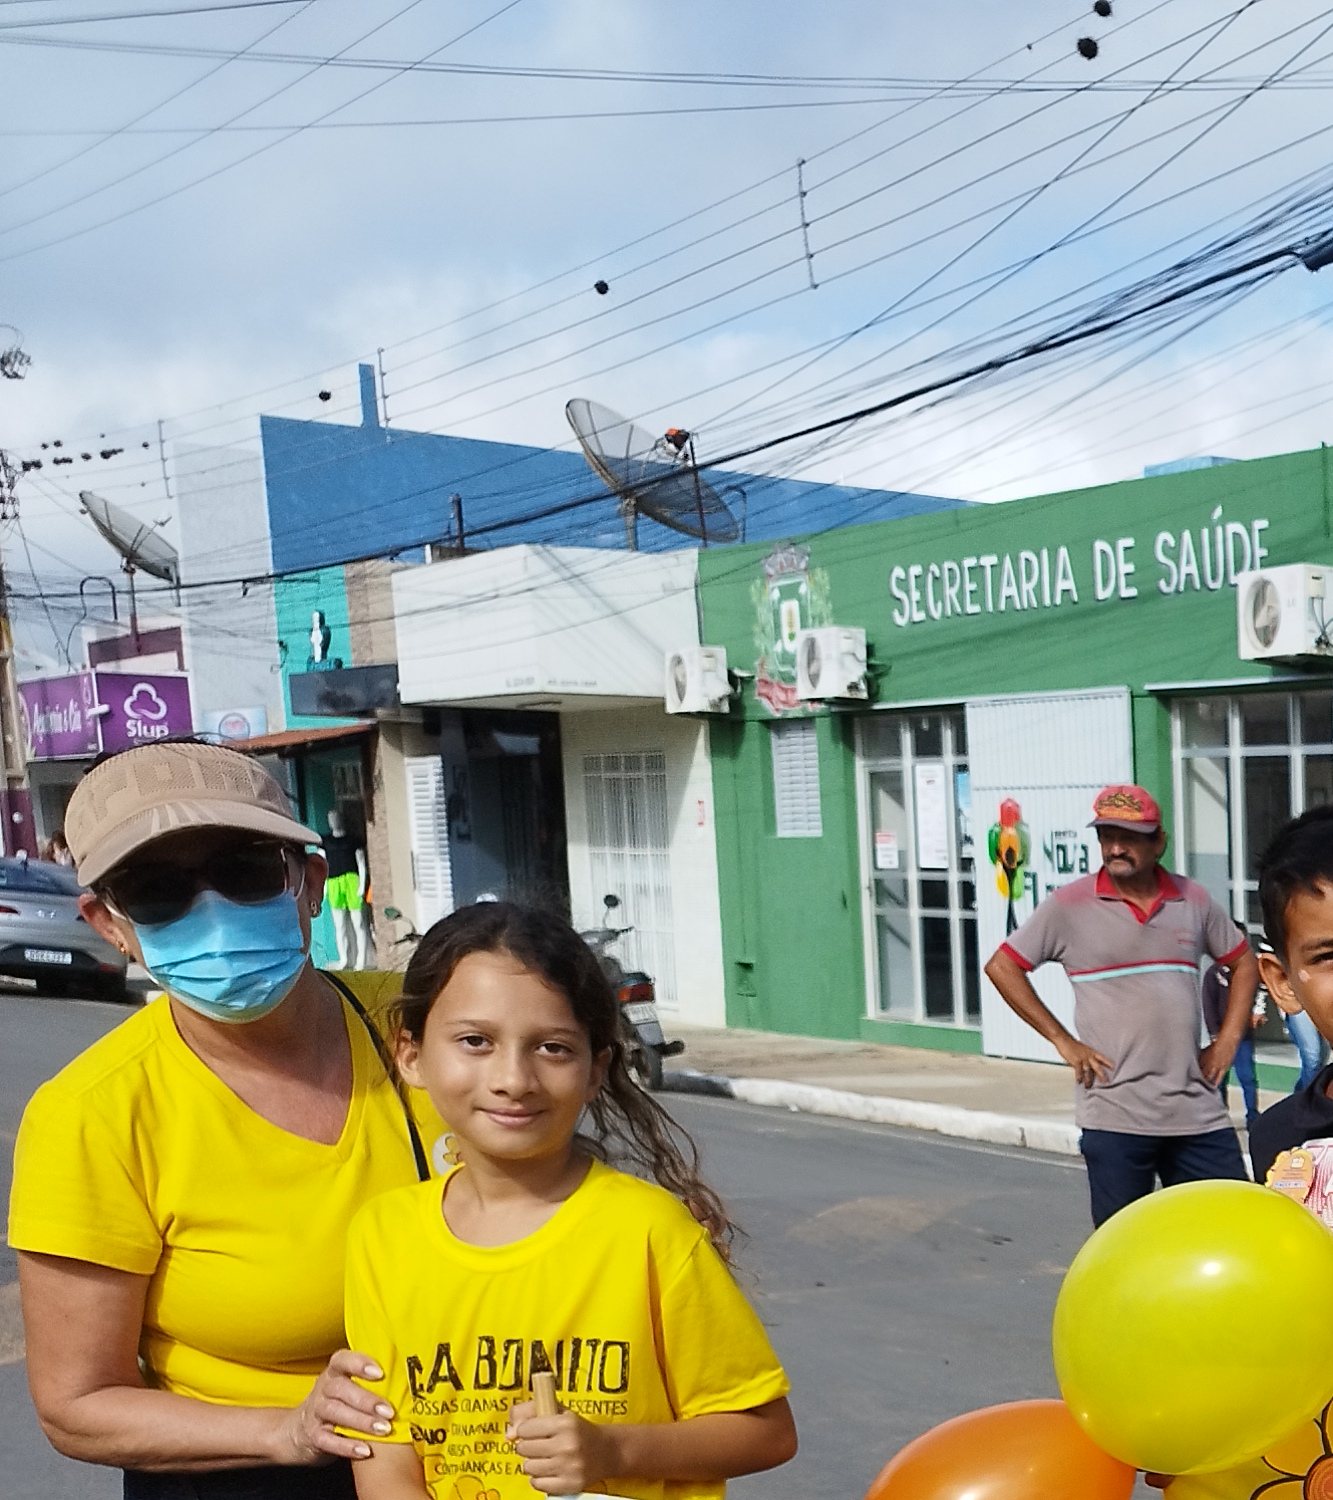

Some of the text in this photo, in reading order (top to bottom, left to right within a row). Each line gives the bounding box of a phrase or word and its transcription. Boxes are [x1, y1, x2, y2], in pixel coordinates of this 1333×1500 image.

[889, 504, 1270, 627] SECRETARIA DE SAÚDE
